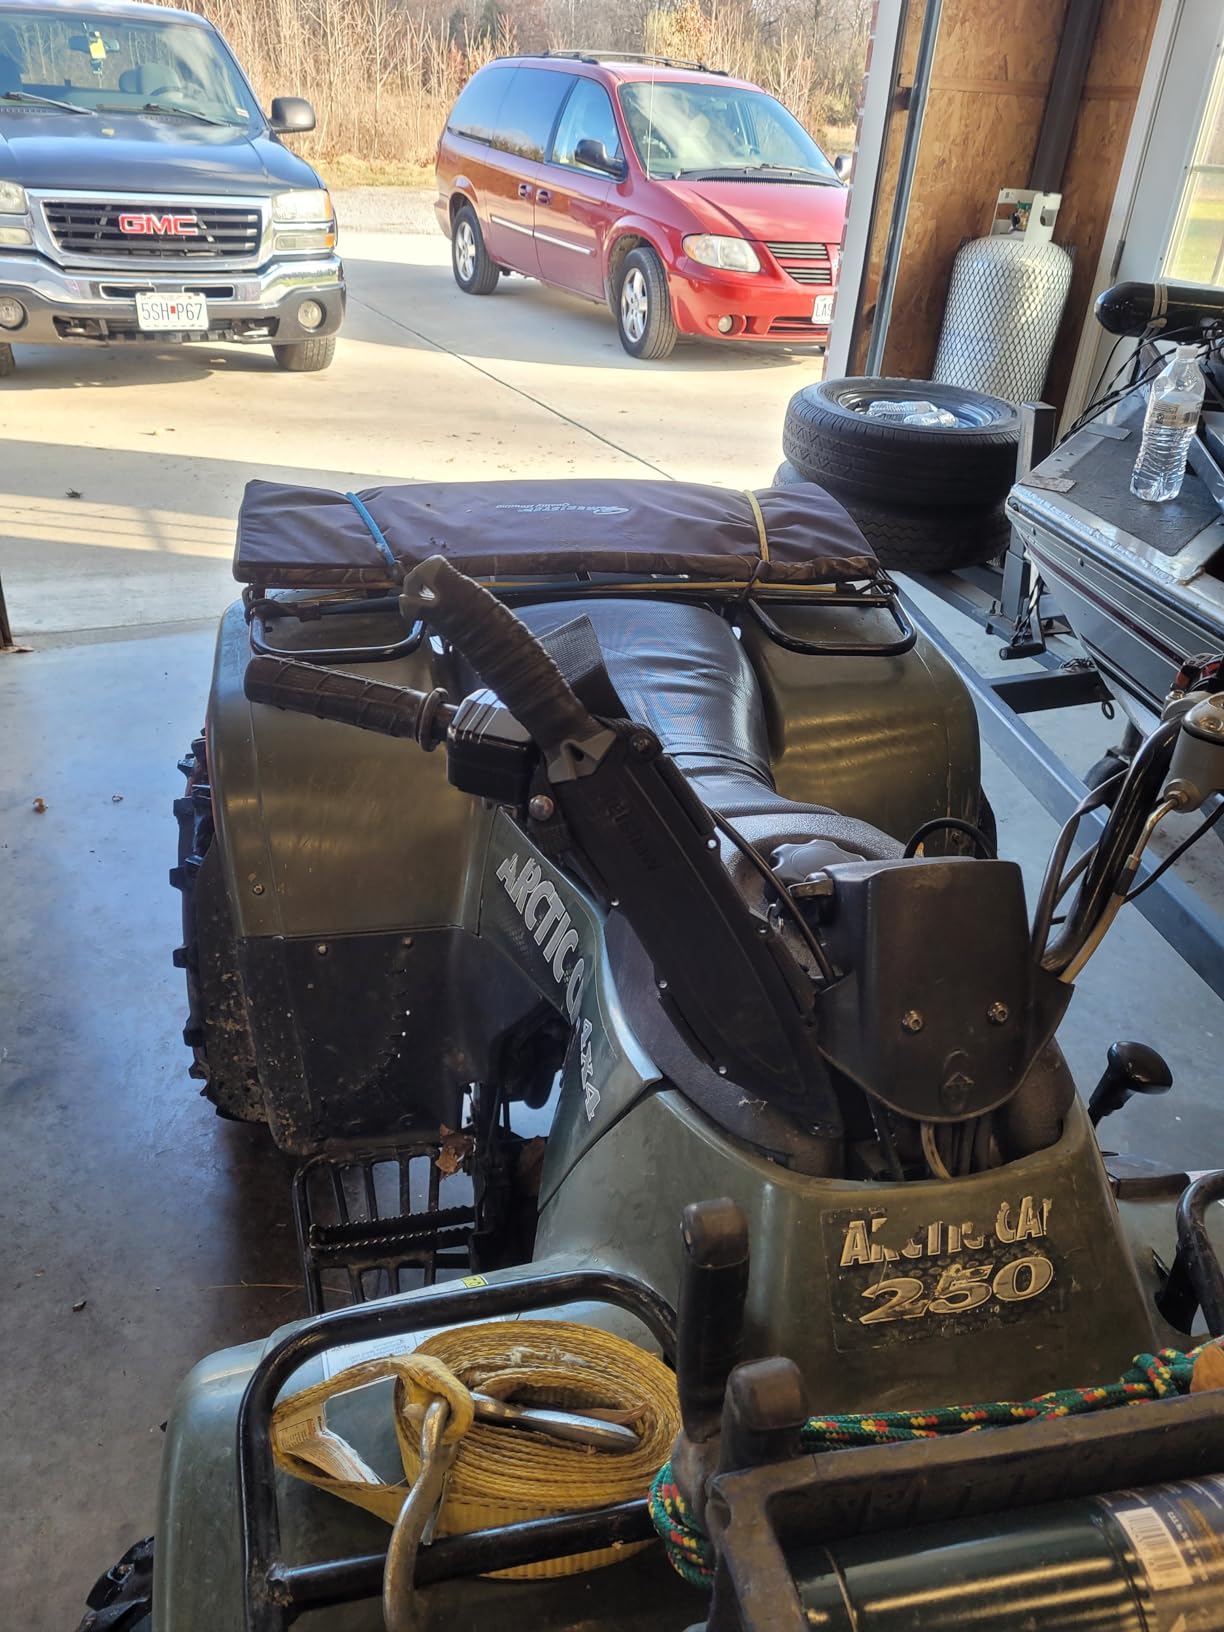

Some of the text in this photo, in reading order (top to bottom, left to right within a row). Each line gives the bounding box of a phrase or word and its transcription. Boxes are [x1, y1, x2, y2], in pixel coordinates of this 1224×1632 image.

[118, 213, 199, 236] GMC
[496, 852, 580, 984] ARCTIC
[858, 1256, 1054, 1325] 250
